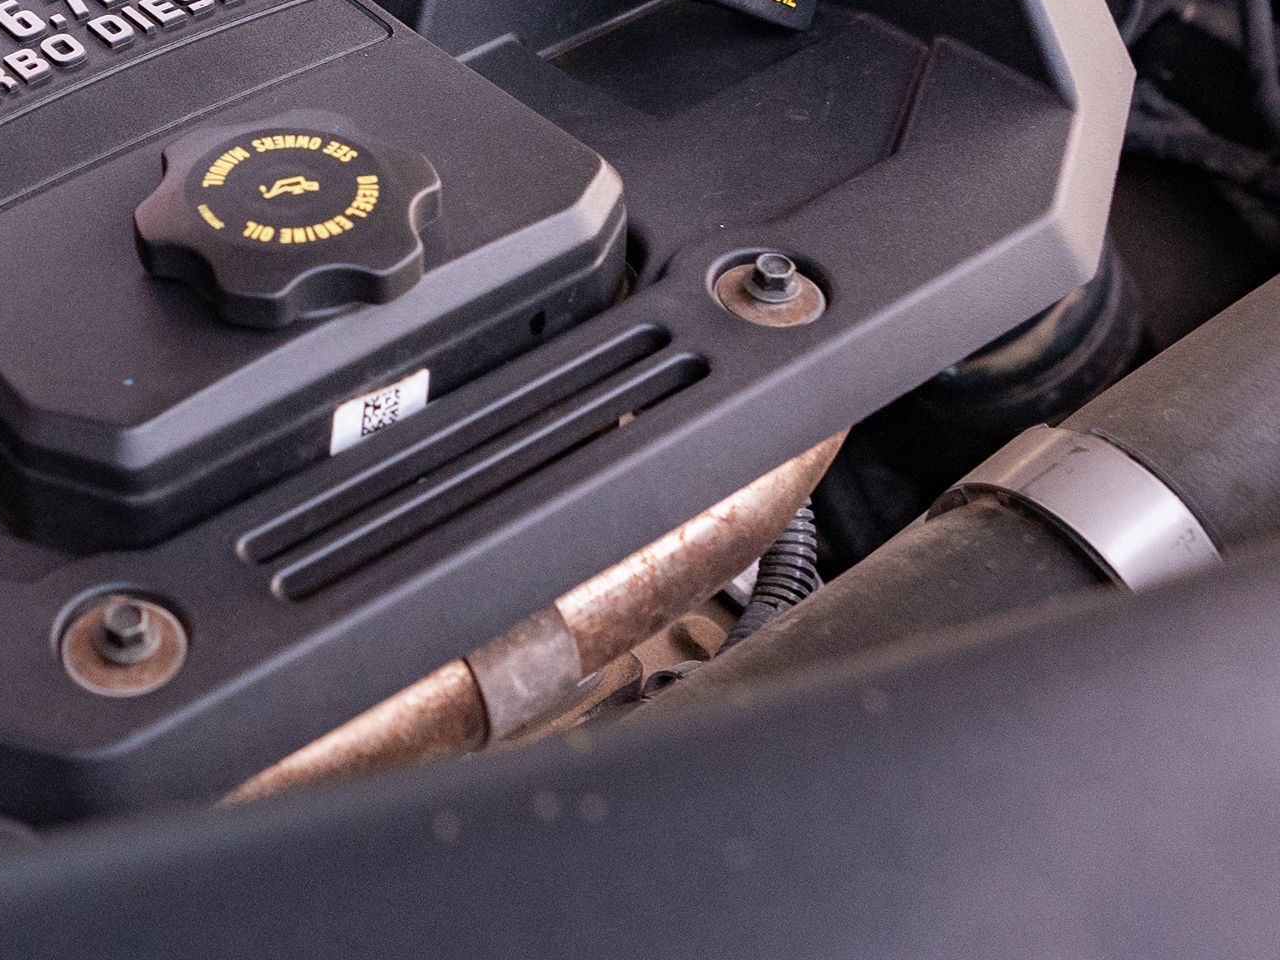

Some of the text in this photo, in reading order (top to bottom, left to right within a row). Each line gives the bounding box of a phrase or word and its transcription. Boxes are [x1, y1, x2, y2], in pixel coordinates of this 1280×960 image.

[201, 134, 359, 188] SEE OWNERS MANUAL
[242, 174, 380, 245] DIESEL ENGINE OIL
